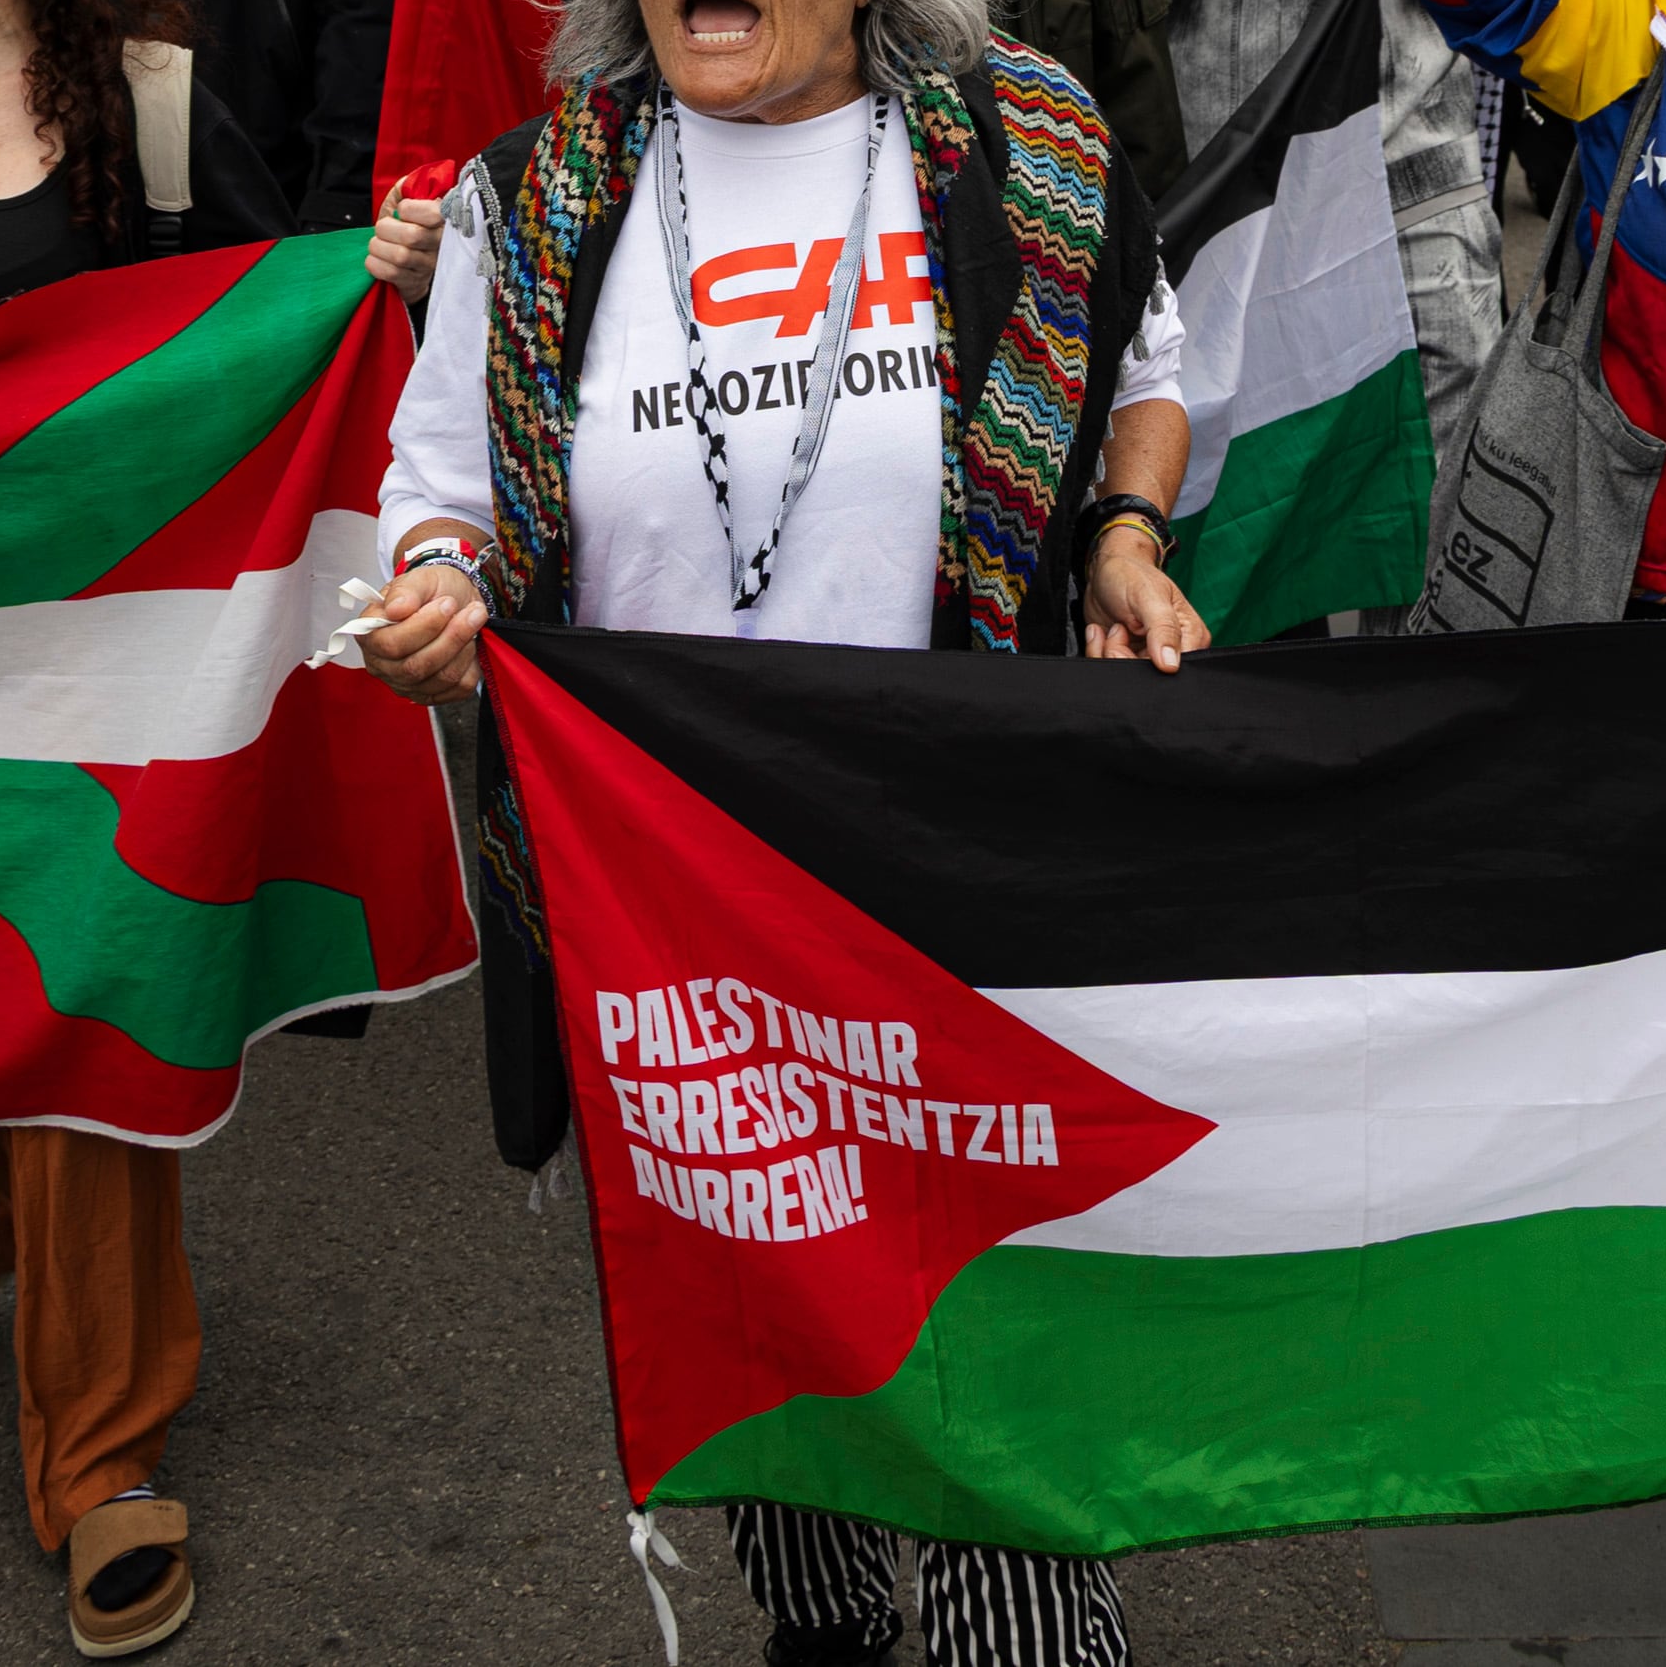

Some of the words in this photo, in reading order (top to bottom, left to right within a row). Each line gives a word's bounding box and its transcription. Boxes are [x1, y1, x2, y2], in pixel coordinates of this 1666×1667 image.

[690, 231, 933, 338] CAF
[596, 977, 922, 1088] PALESTINAR
[609, 1062, 1060, 1167] ERRESISTENTZIA
[629, 1144, 869, 1242] AURRERA!
